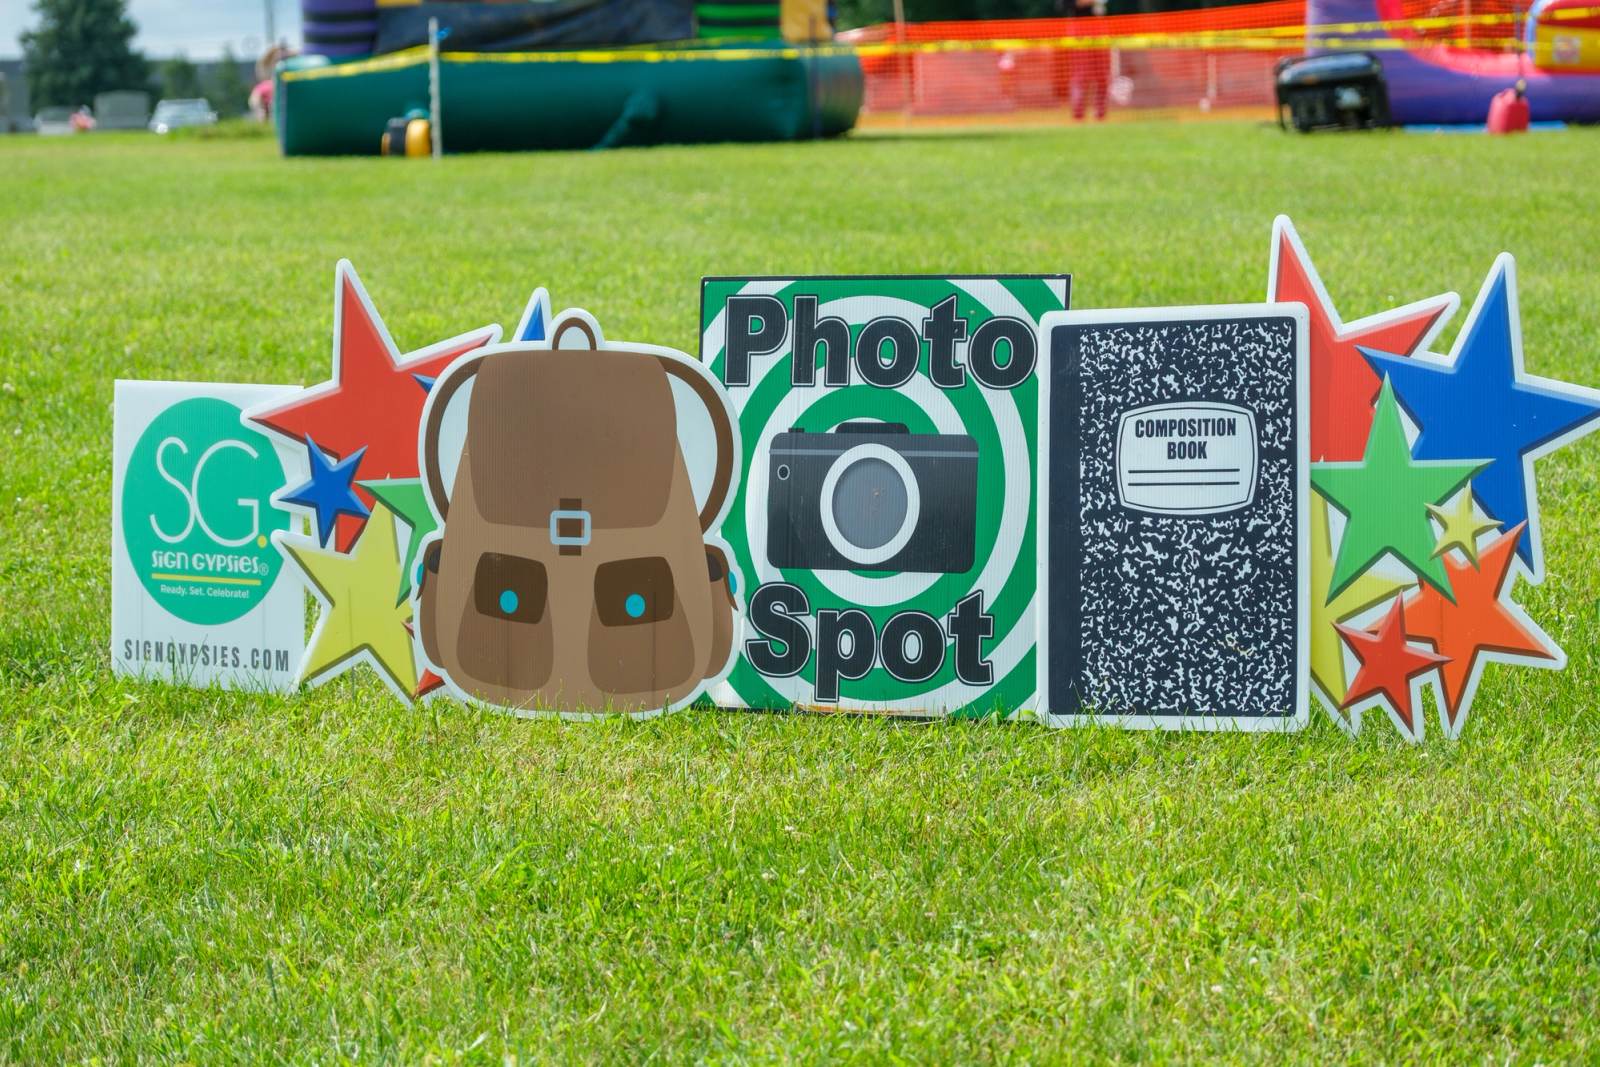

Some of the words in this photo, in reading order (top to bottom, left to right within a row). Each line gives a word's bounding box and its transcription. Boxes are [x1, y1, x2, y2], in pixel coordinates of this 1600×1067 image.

[724, 293, 1038, 389] Photo
[1135, 418, 1237, 438] COMPOSITION
[1167, 441, 1208, 460] BOOK
[160, 584, 188, 597] Ready.
[189, 585, 205, 596] Set.
[206, 587, 250, 599] Celebrate!
[745, 581, 995, 703] Spot
[124, 639, 289, 672] SIGNGYPSIES.COM
